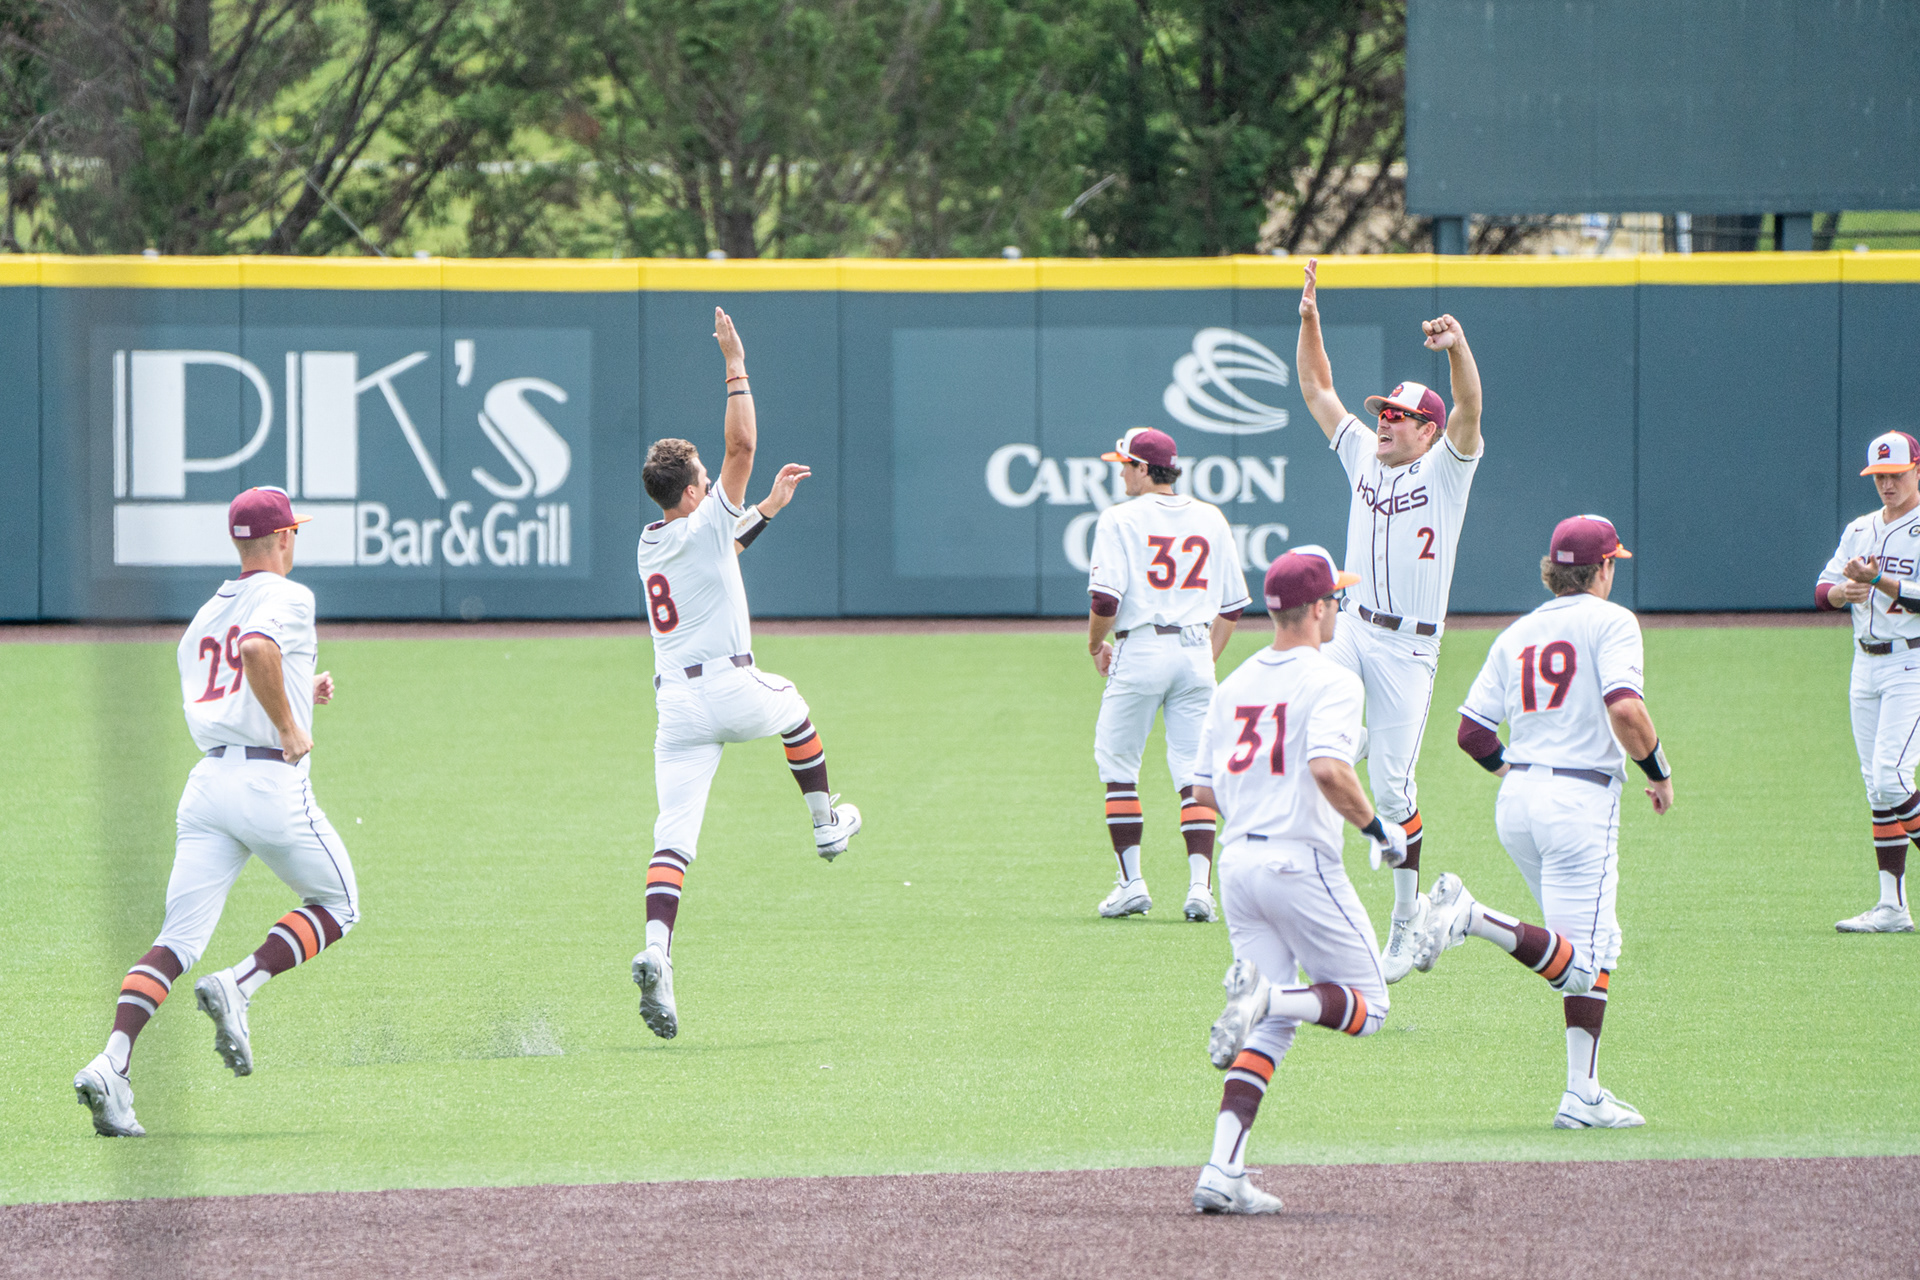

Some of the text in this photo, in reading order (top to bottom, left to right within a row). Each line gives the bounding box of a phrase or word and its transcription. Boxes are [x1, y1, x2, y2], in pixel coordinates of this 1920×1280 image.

[112, 339, 572, 500] PK's
[985, 443, 1289, 511] CARIION
[1357, 474, 1429, 516] HOKIES
[356, 502, 570, 567] Bar&Grill
[1147, 534, 1211, 590] 32
[1416, 526, 1436, 560] 2
[647, 572, 680, 634] 8
[193, 624, 245, 703] 29
[1516, 639, 1578, 713] 19
[1227, 702, 1289, 776] 31
